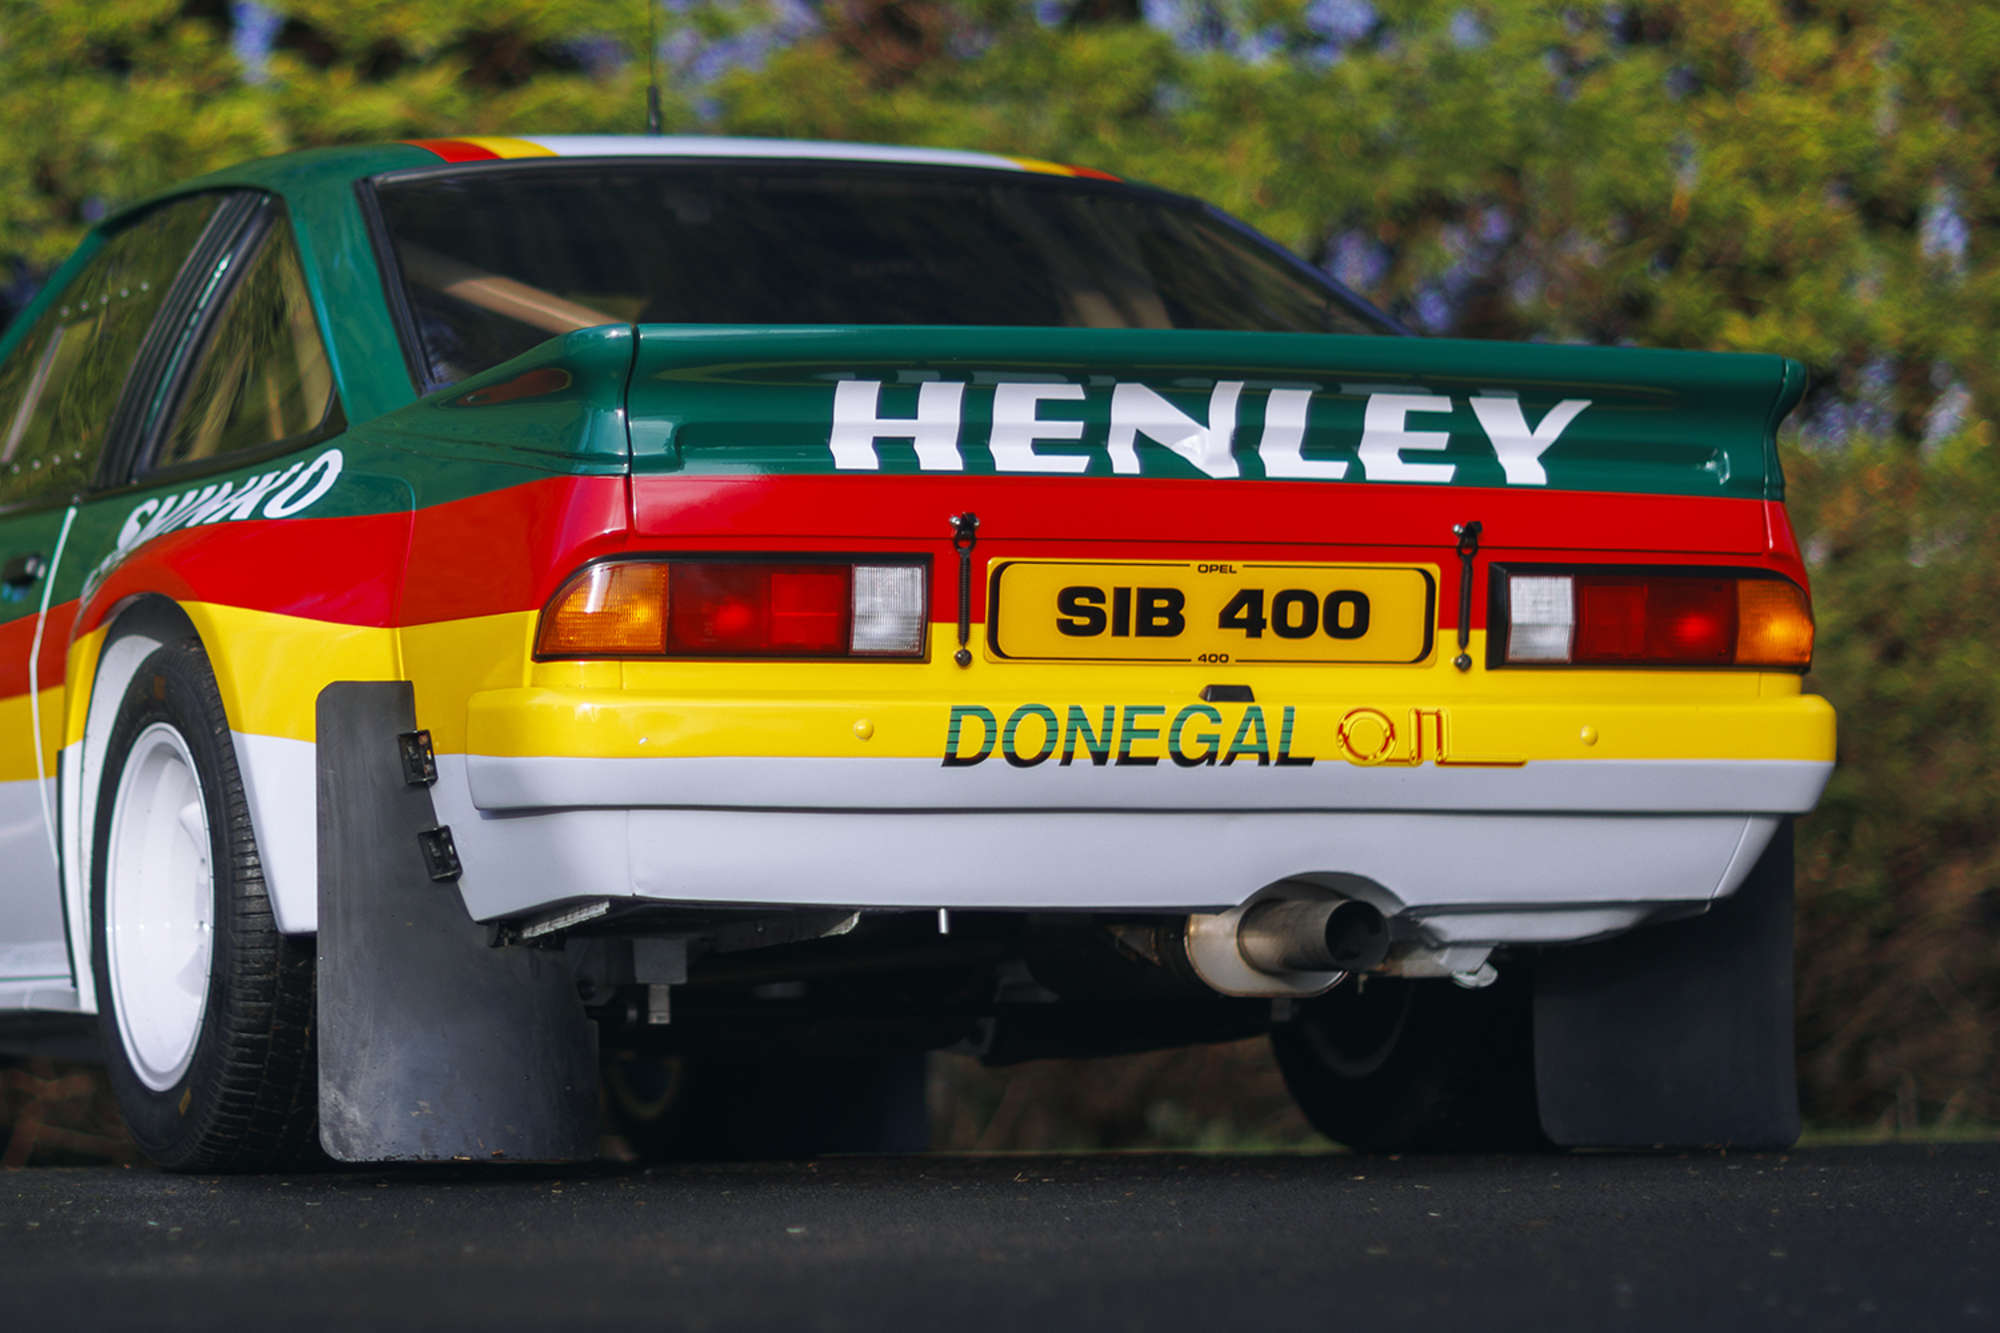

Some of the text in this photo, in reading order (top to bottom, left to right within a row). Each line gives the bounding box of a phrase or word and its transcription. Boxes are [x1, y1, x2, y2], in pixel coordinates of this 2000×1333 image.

[829, 380, 1592, 486] HENLEY
[1197, 563, 1238, 575] OPEL
[1056, 586, 1370, 641] SIB 400
[1197, 653, 1230, 664] 400
[941, 703, 1315, 768] DONEGAL
